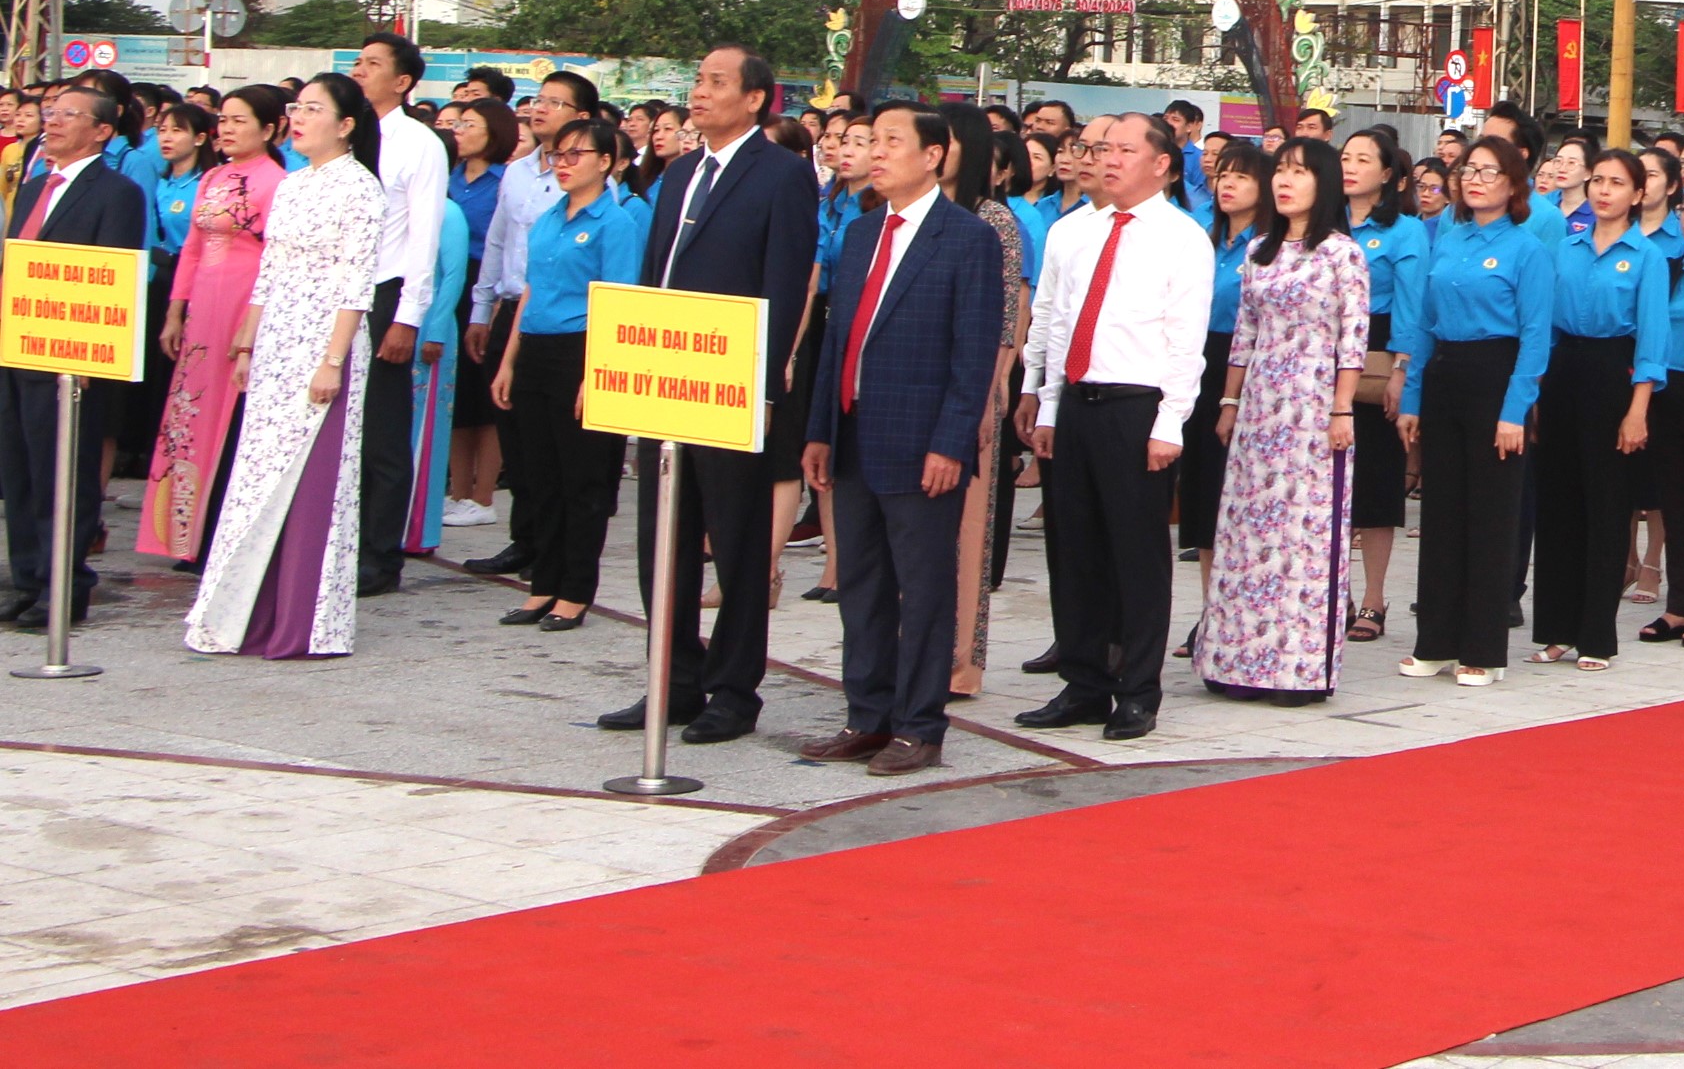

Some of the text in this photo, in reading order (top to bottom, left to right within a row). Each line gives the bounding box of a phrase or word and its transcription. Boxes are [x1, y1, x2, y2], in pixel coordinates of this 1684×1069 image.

[27, 260, 116, 287] ĐOÀN ĐẠI BIỂU
[12, 294, 128, 327] HỘI ĐỒNG NHÂN DÂN
[20, 331, 116, 364] TỈNH KHÁNH HOÀ
[617, 323, 728, 356] ĐOÀN ĐẠI BIỂU
[594, 363, 748, 409] TỈNH UỶ KHÁNH HOÀ
